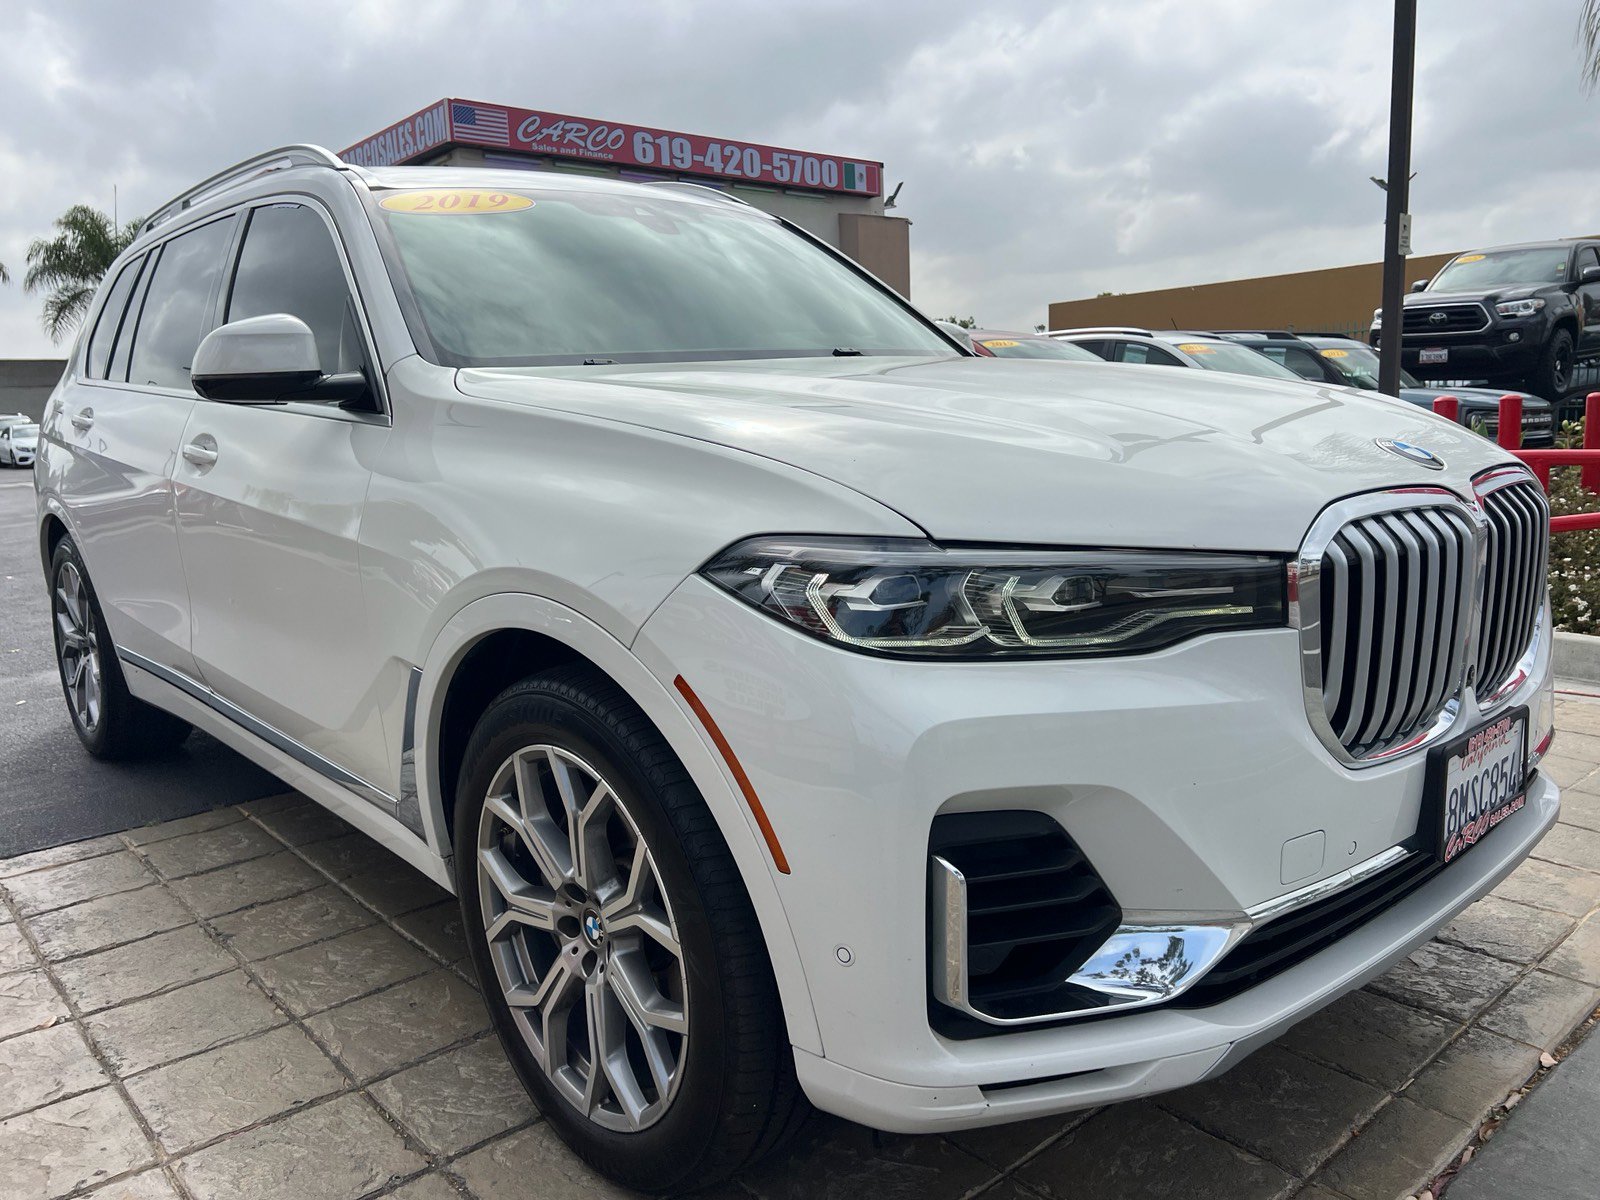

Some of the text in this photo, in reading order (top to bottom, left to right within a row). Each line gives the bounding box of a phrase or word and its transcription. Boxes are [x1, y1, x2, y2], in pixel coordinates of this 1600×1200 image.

[516, 115, 625, 151] CARCO
[532, 142, 614, 160] Sales and Finance
[633, 131, 839, 188] 619-420-5700
[411, 194, 510, 211] 2019
[1446, 751, 1518, 836] 8MSC854
